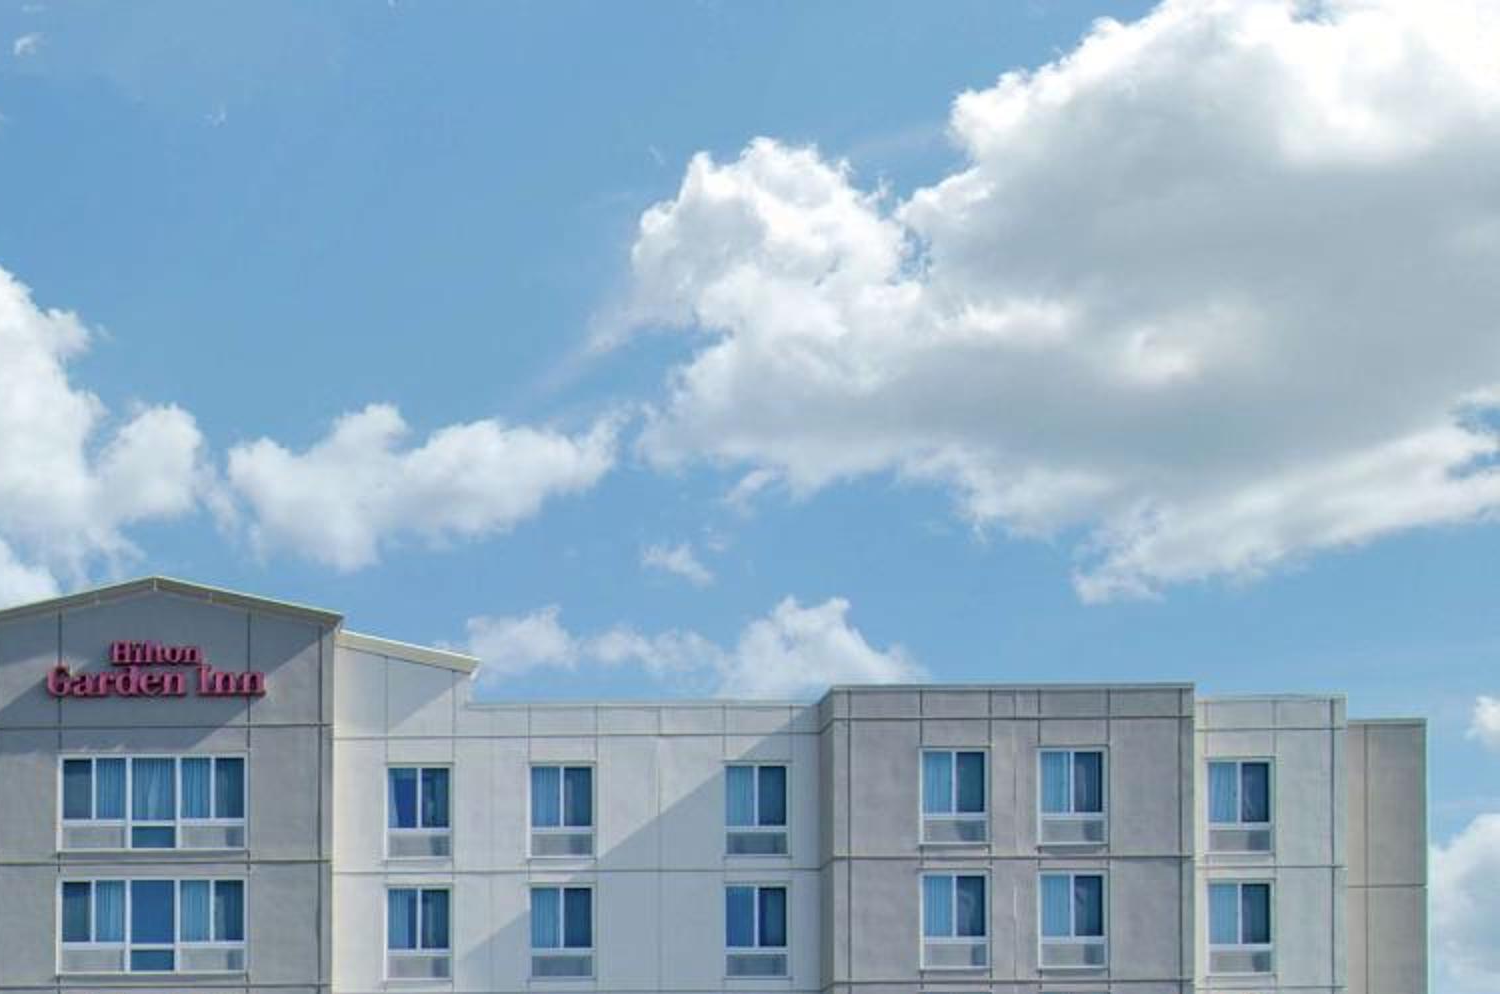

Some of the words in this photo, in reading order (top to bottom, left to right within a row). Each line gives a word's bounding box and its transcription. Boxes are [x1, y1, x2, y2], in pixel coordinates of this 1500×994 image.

[110, 640, 204, 664] Hilton
[46, 664, 186, 697] Garden
[196, 665, 266, 697] Inn
